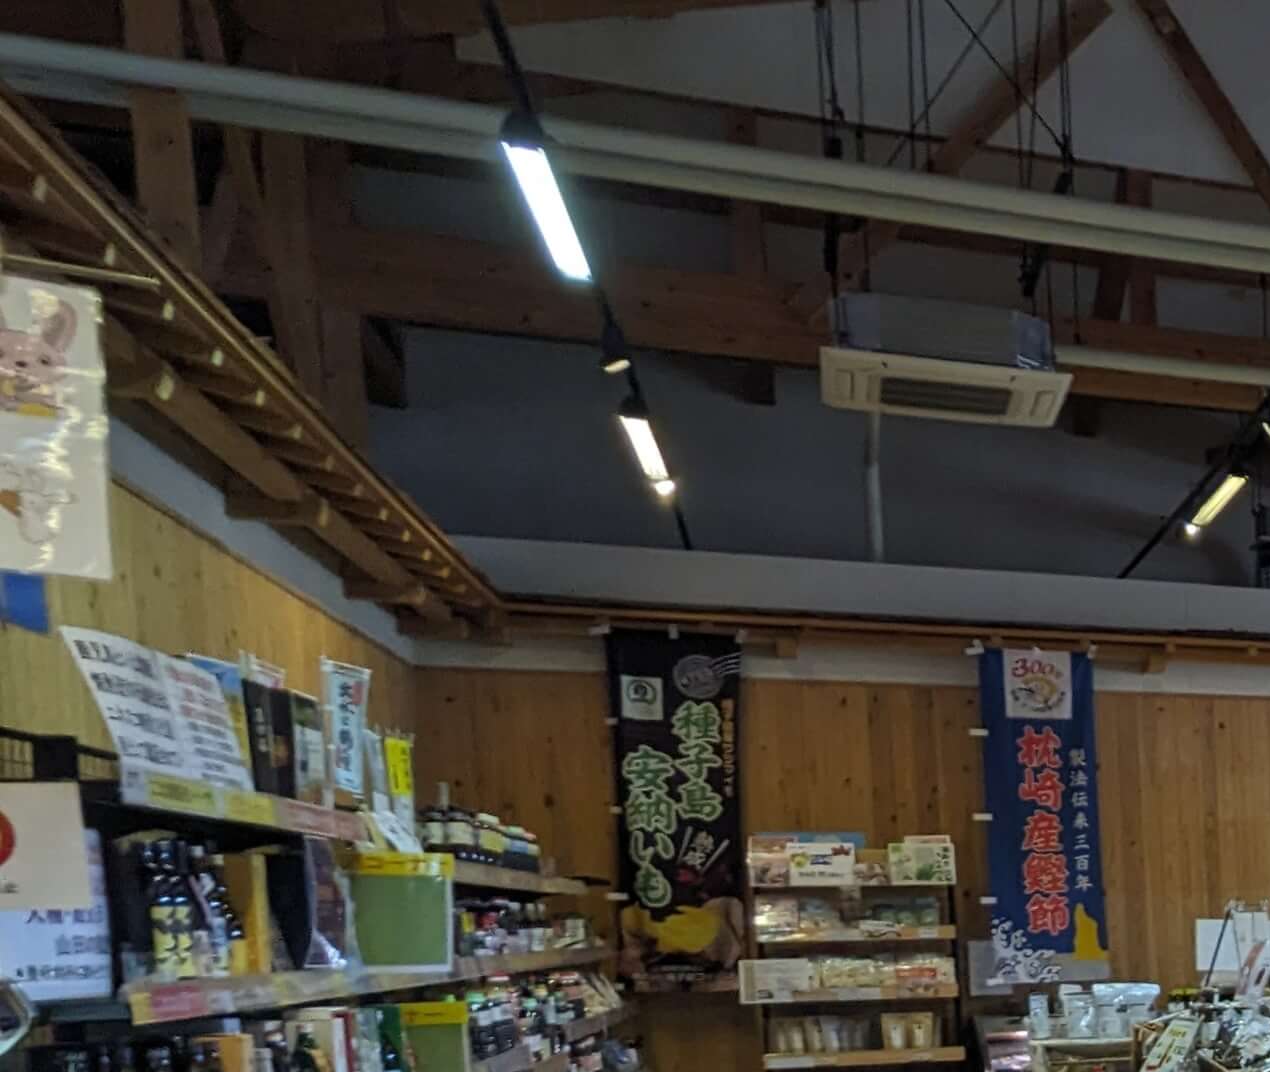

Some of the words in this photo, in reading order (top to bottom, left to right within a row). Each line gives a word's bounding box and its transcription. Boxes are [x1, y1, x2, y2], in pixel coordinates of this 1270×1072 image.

[622, 745, 677, 908] 安納いも
[671, 701, 723, 822] 種子島
[1018, 724, 1071, 936] 枕崎産鰹節
[1069, 748, 1093, 891] 製法伝来三百年
